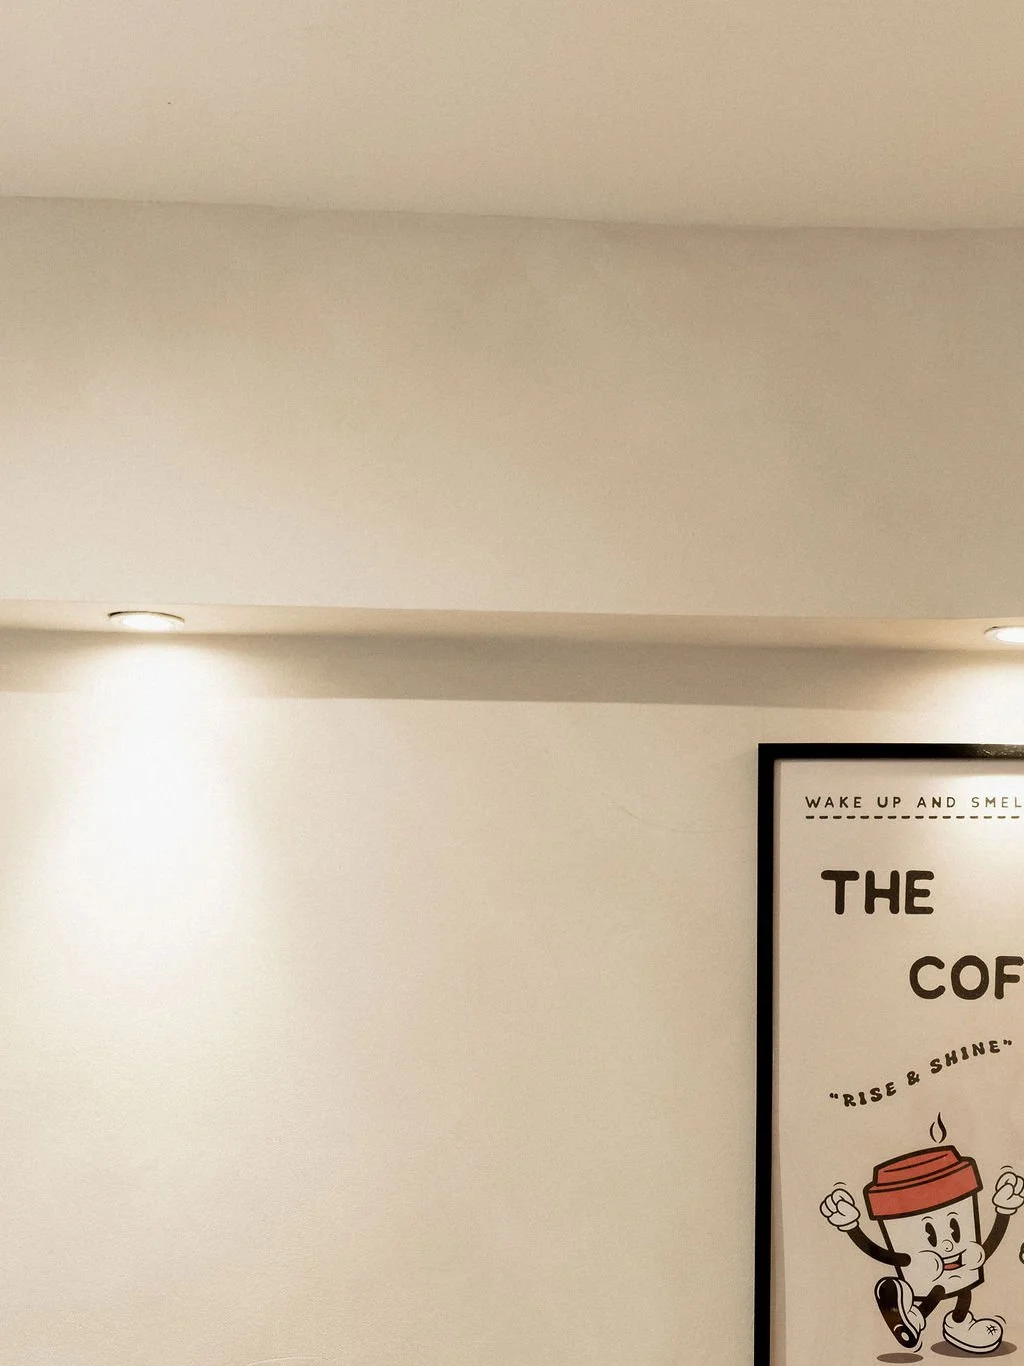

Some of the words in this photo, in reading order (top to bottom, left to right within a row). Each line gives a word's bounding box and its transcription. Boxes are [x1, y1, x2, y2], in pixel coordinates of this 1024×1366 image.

[804, 795, 862, 809] WAKE
[876, 796, 902, 809] UP
[916, 796, 956, 809] AND
[820, 869, 935, 916] THE
[906, 1071, 921, 1086] &
